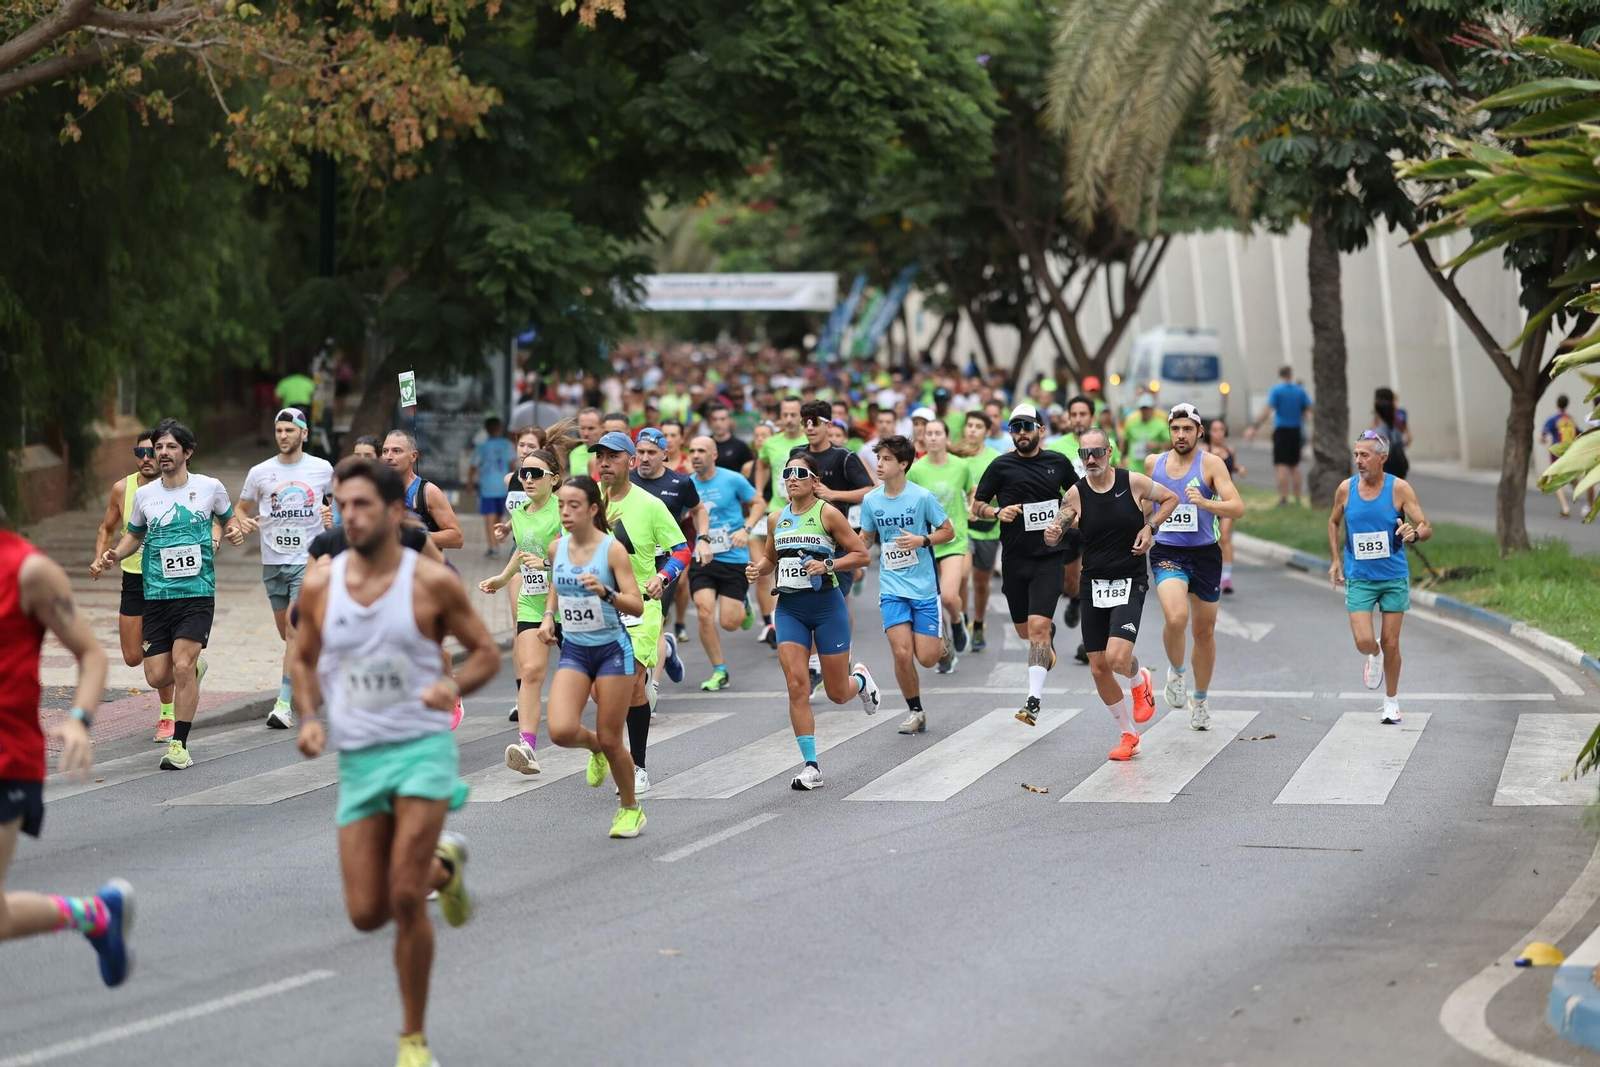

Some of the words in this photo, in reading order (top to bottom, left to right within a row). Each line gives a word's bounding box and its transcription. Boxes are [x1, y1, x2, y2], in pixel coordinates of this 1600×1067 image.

[508, 500, 526, 510] 30
[270, 509, 314, 518] MARBELLA
[1029, 510, 1055, 522] 604
[876, 513, 915, 528] nerja
[276, 535, 301, 546] 699
[775, 535, 821, 546] RREMOLINOS
[1358, 541, 1383, 552] 583
[166, 556, 196, 569] 218
[780, 567, 808, 578] 1126
[523, 574, 544, 584] 1023
[557, 576, 586, 589] ner
[1096, 588, 1127, 598] 1183
[564, 608, 595, 622] 834
